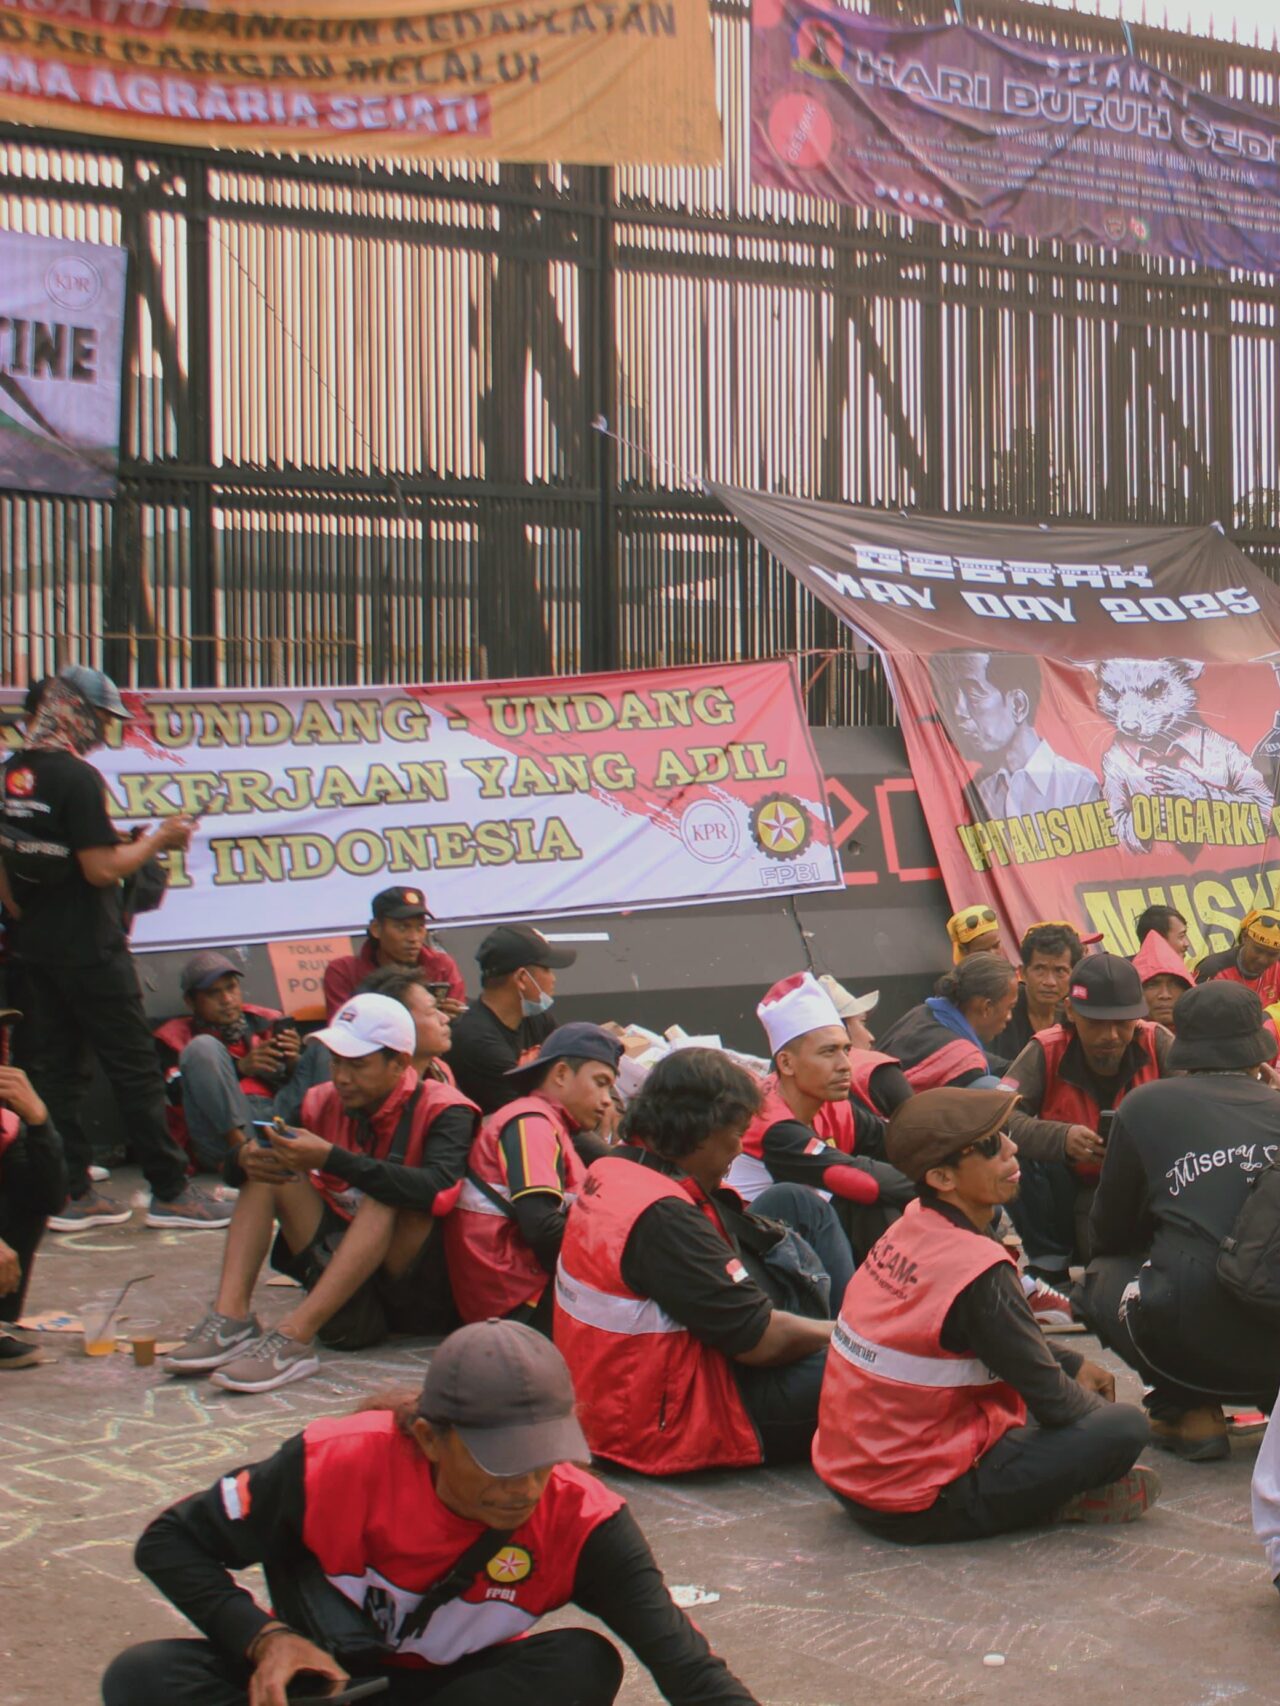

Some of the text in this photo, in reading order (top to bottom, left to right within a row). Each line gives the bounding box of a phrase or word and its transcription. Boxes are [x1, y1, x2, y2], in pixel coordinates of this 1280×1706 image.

[177, 8, 378, 43] BANGUN
[345, 50, 540, 84] MELALUI
[91, 68, 320, 128] AGRARIA
[856, 48, 990, 110] HARI
[1003, 78, 1172, 141] BURUH
[850, 543, 1154, 589] GEBRAK
[809, 565, 1261, 623] MAY DAY 2025
[146, 698, 431, 748] UNDANG
[484, 686, 736, 737] UNDANG
[463, 752, 635, 798] YANG
[655, 742, 787, 787] ADIL
[693, 821, 728, 842] KPR
[1131, 794, 1266, 846] OLIGARKI
[210, 816, 583, 885] INDONESIA
[760, 863, 821, 887] FPBI
[288, 945, 333, 955] TOLAK
[1165, 1143, 1263, 1197] Misery
[485, 1587, 517, 1602] FPBI
